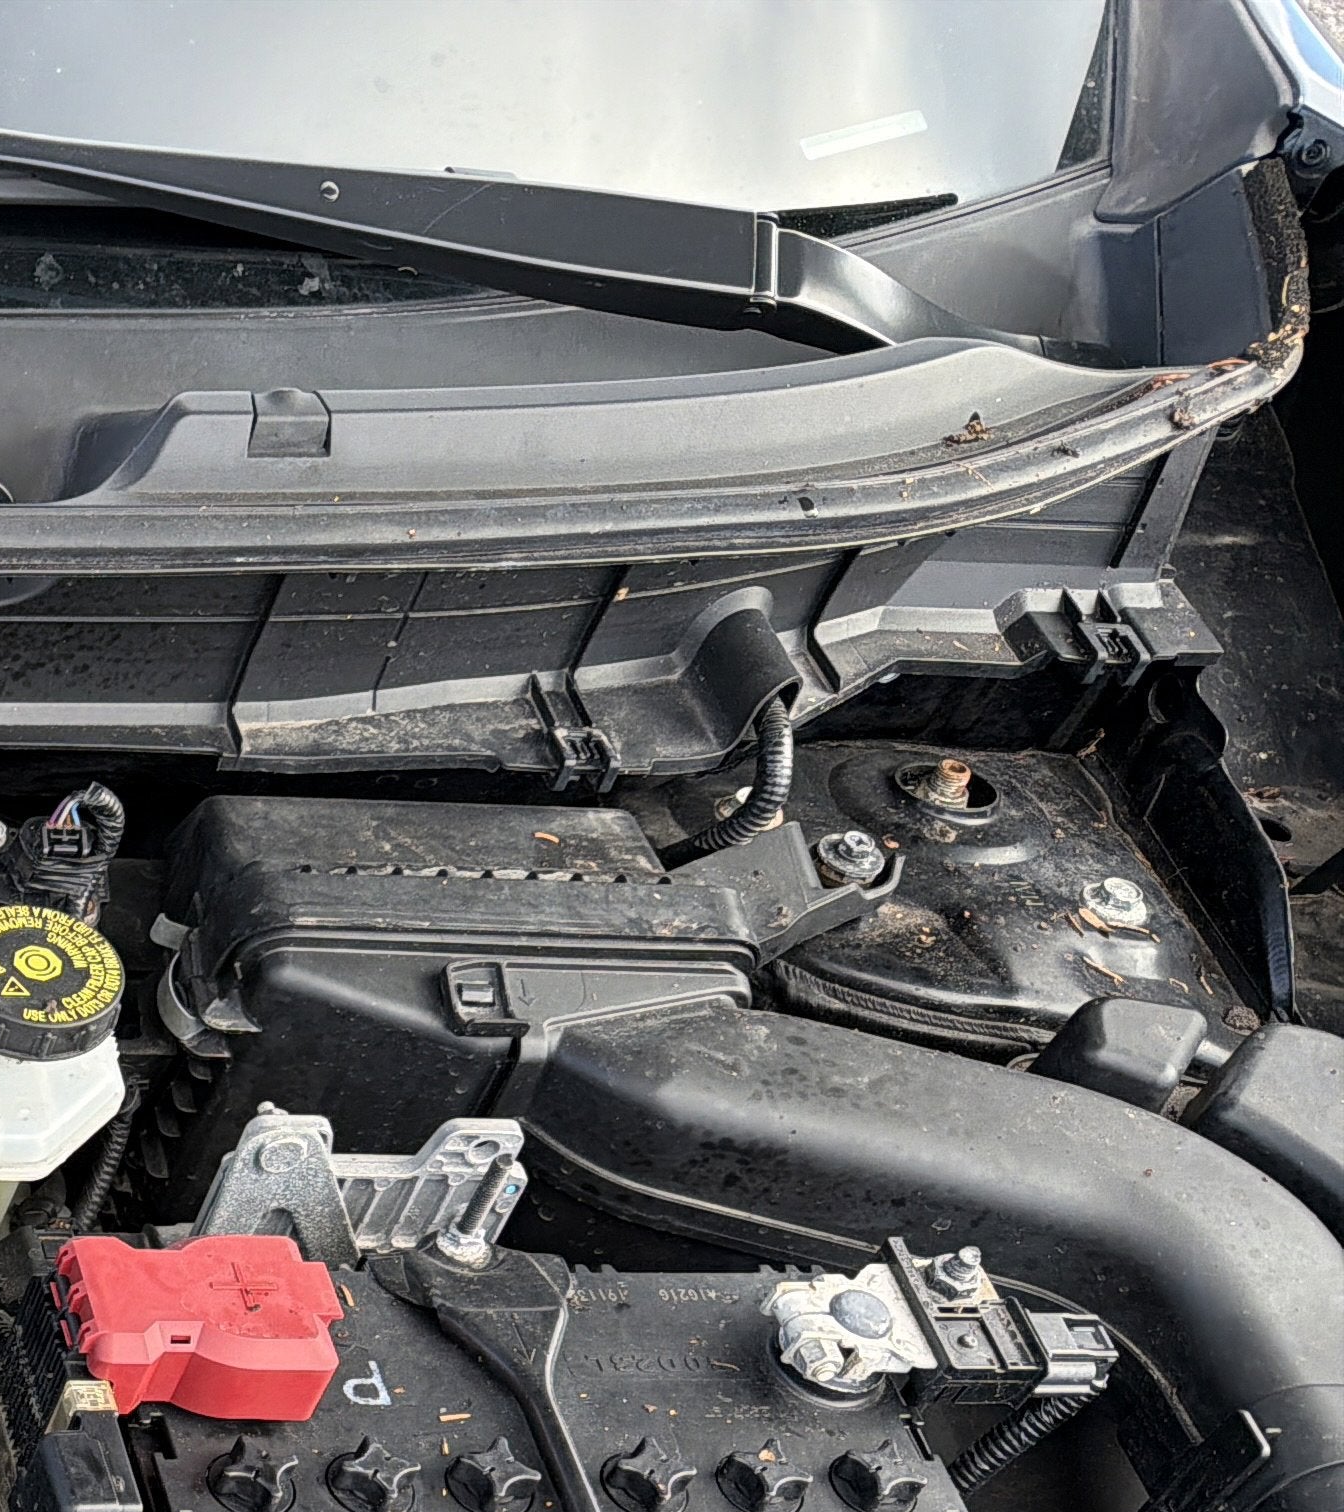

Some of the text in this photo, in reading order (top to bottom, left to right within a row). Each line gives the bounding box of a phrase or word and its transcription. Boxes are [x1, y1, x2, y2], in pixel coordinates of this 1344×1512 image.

[32, 906, 41, 917] A
[42, 908, 76, 926] FROM
[45, 918, 89, 950] BEFORE
[73, 920, 100, 944] FLUID
[46, 932, 89, 969] WARNING
[82, 946, 102, 963] CAP
[95, 943, 121, 970] BRAKE
[61, 987, 96, 1009] CLEAN
[102, 987, 116, 1003] OR
[23, 1008, 47, 1022] USE
[79, 1000, 105, 1020] DOT3
